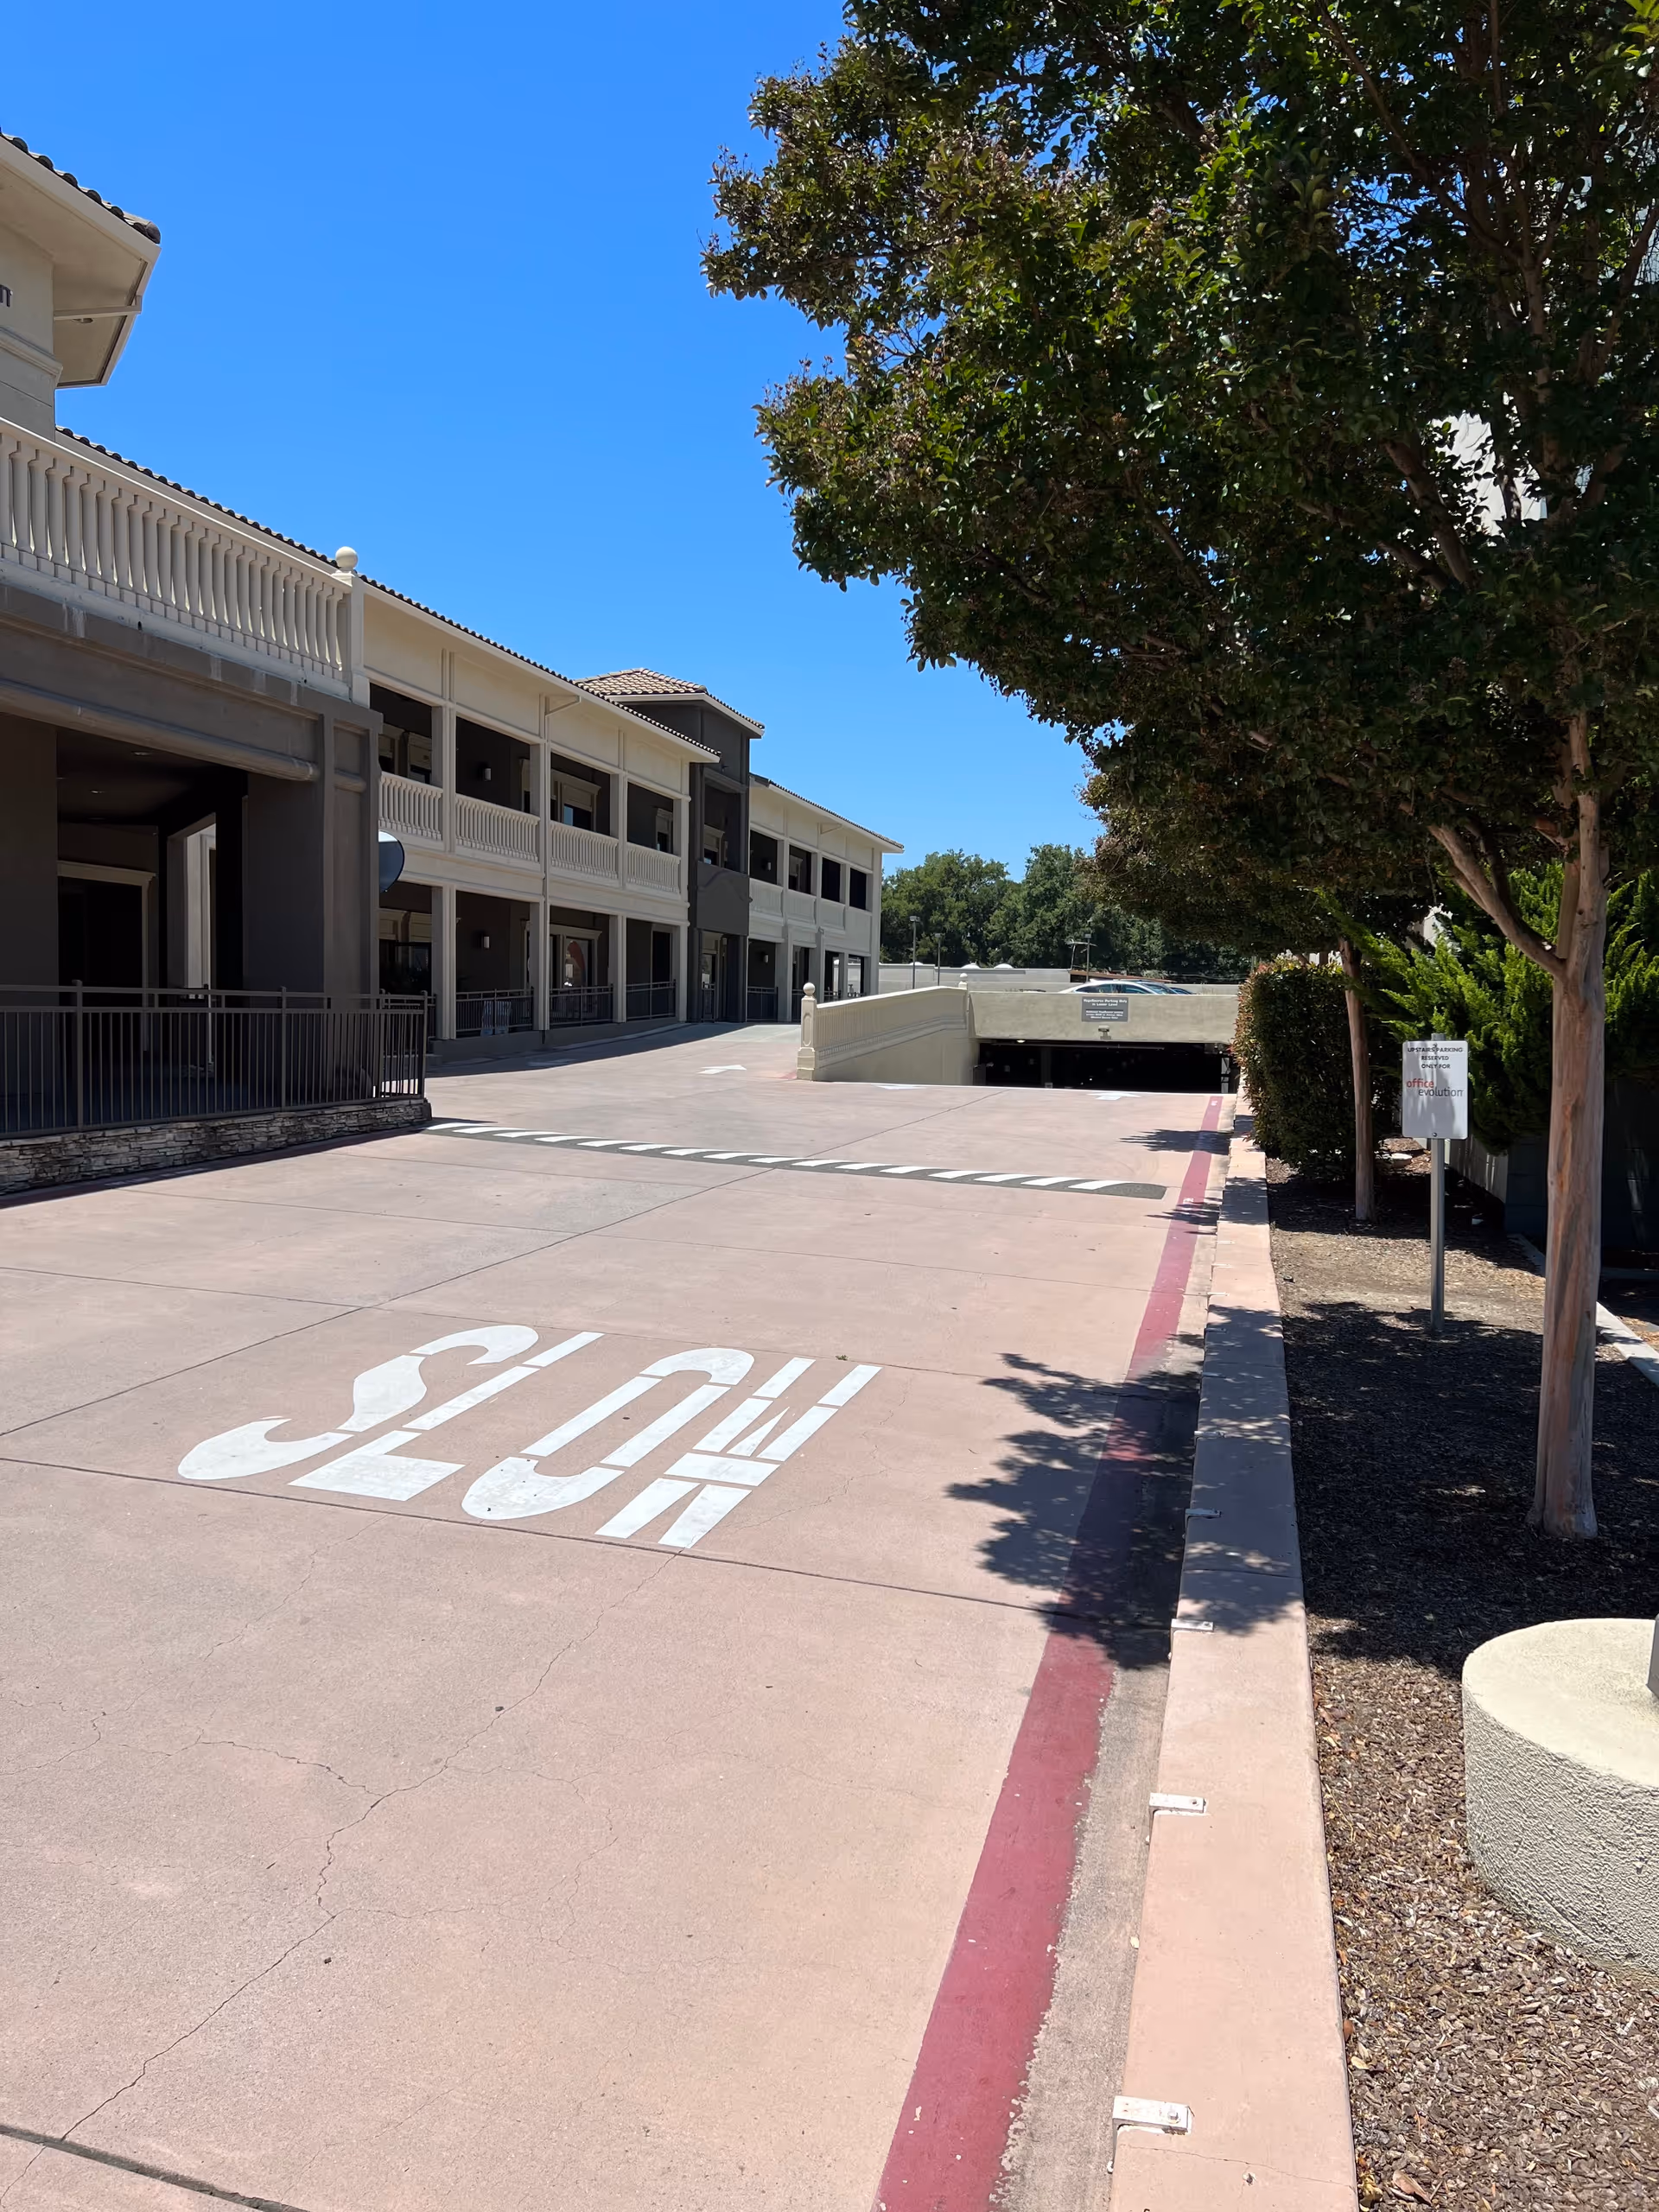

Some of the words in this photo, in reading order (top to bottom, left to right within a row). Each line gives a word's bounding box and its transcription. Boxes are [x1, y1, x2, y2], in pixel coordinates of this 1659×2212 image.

[1407, 1078, 1434, 1088] office
[1418, 1086, 1463, 1096] evolution
[177, 1324, 883, 1550] SLOW
